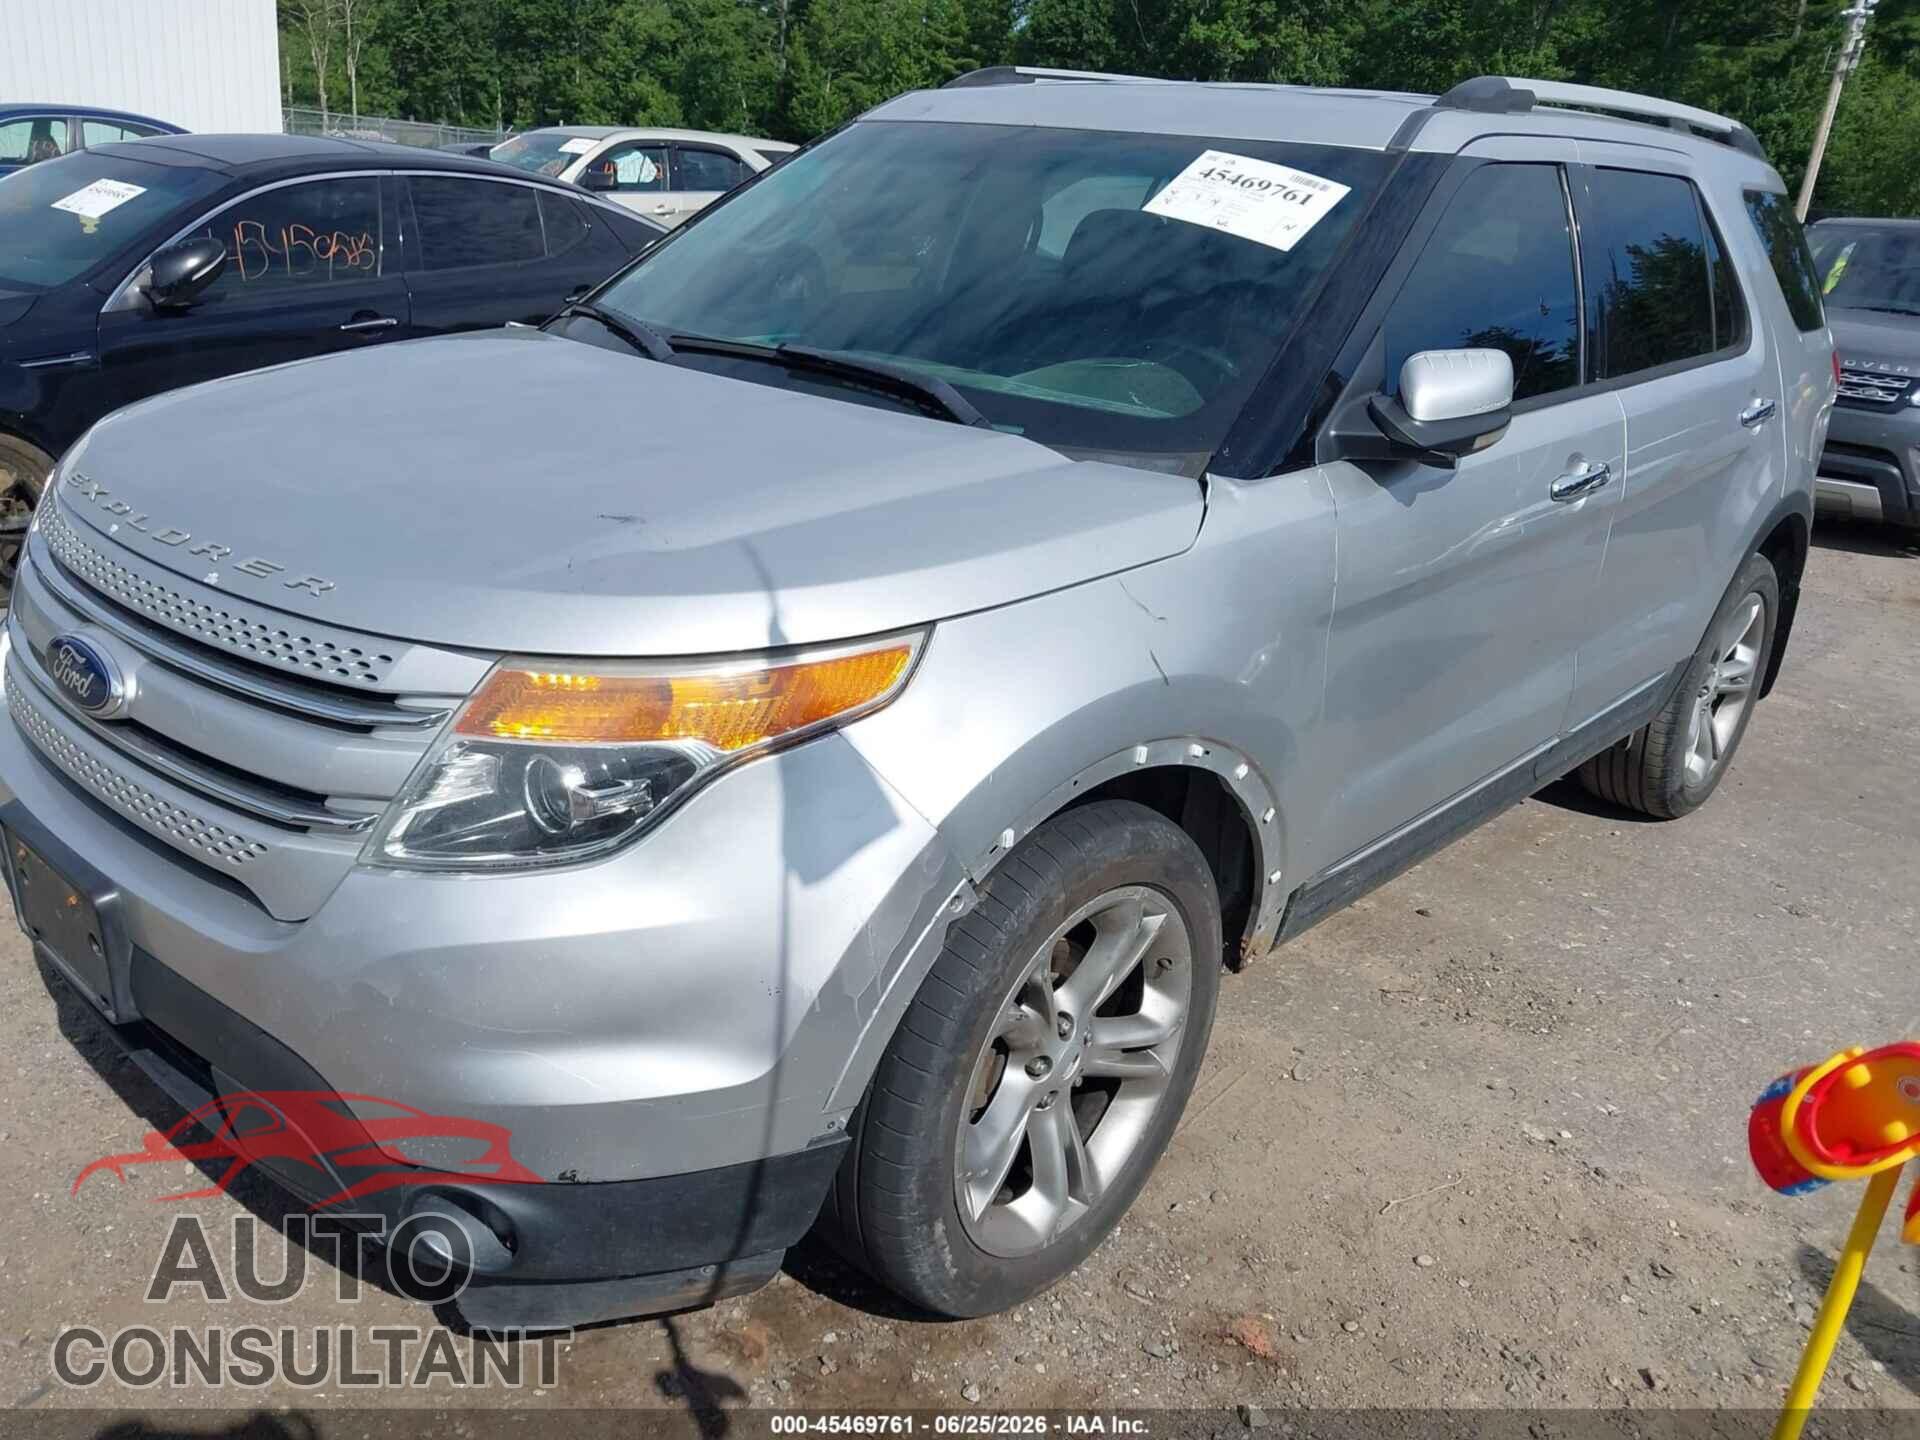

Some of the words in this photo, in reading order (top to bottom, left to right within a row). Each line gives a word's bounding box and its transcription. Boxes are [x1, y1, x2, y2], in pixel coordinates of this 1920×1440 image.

[1199, 167, 1313, 206] 45469761
[1843, 359, 1909, 373] OVER
[66, 472, 336, 597] EXPLORER
[52, 644, 93, 698] Ford
